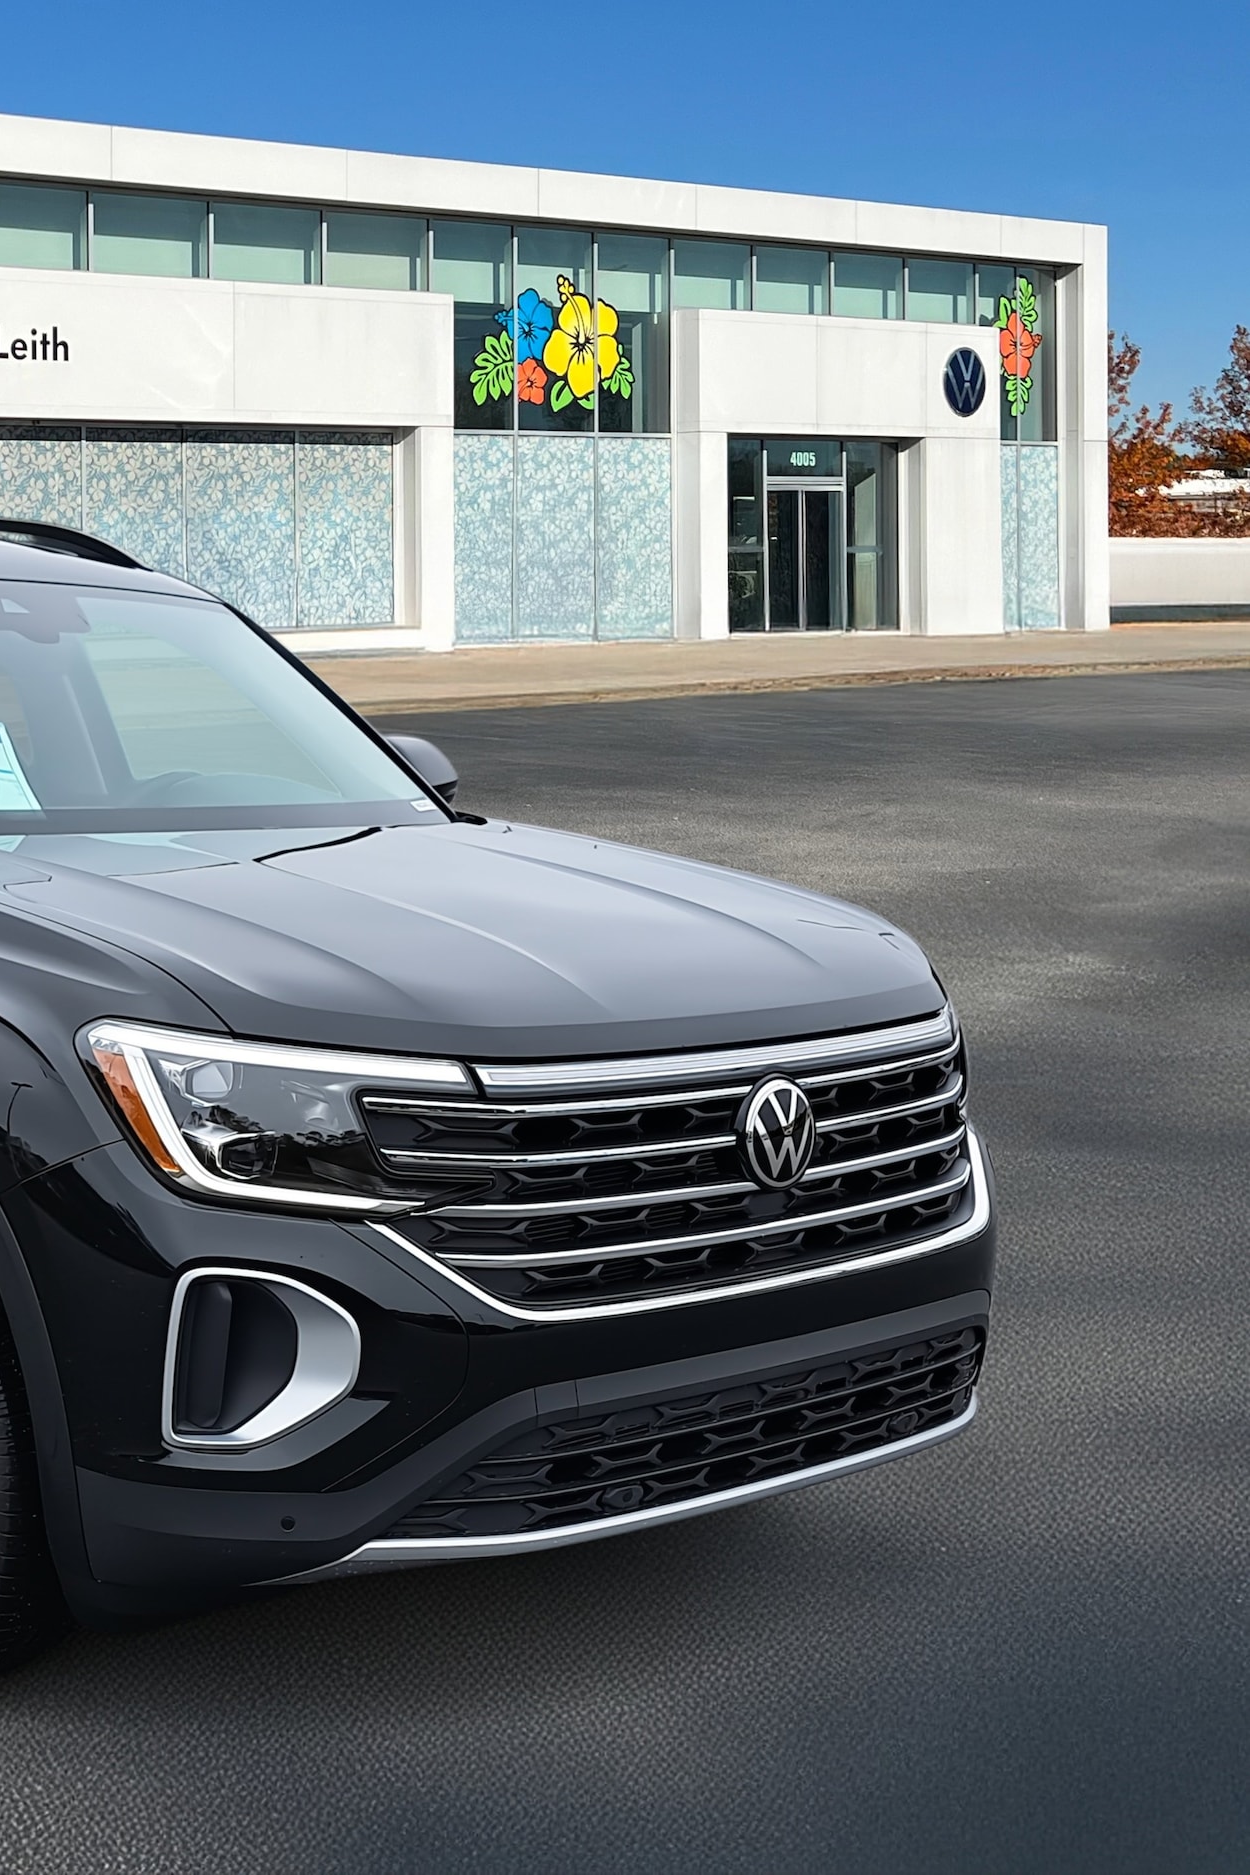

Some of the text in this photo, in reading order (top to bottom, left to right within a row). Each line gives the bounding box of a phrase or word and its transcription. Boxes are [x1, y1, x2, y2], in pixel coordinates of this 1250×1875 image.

[945, 348, 985, 413] VW
[790, 451, 816, 467] 4005
[750, 1083, 812, 1183] VW
